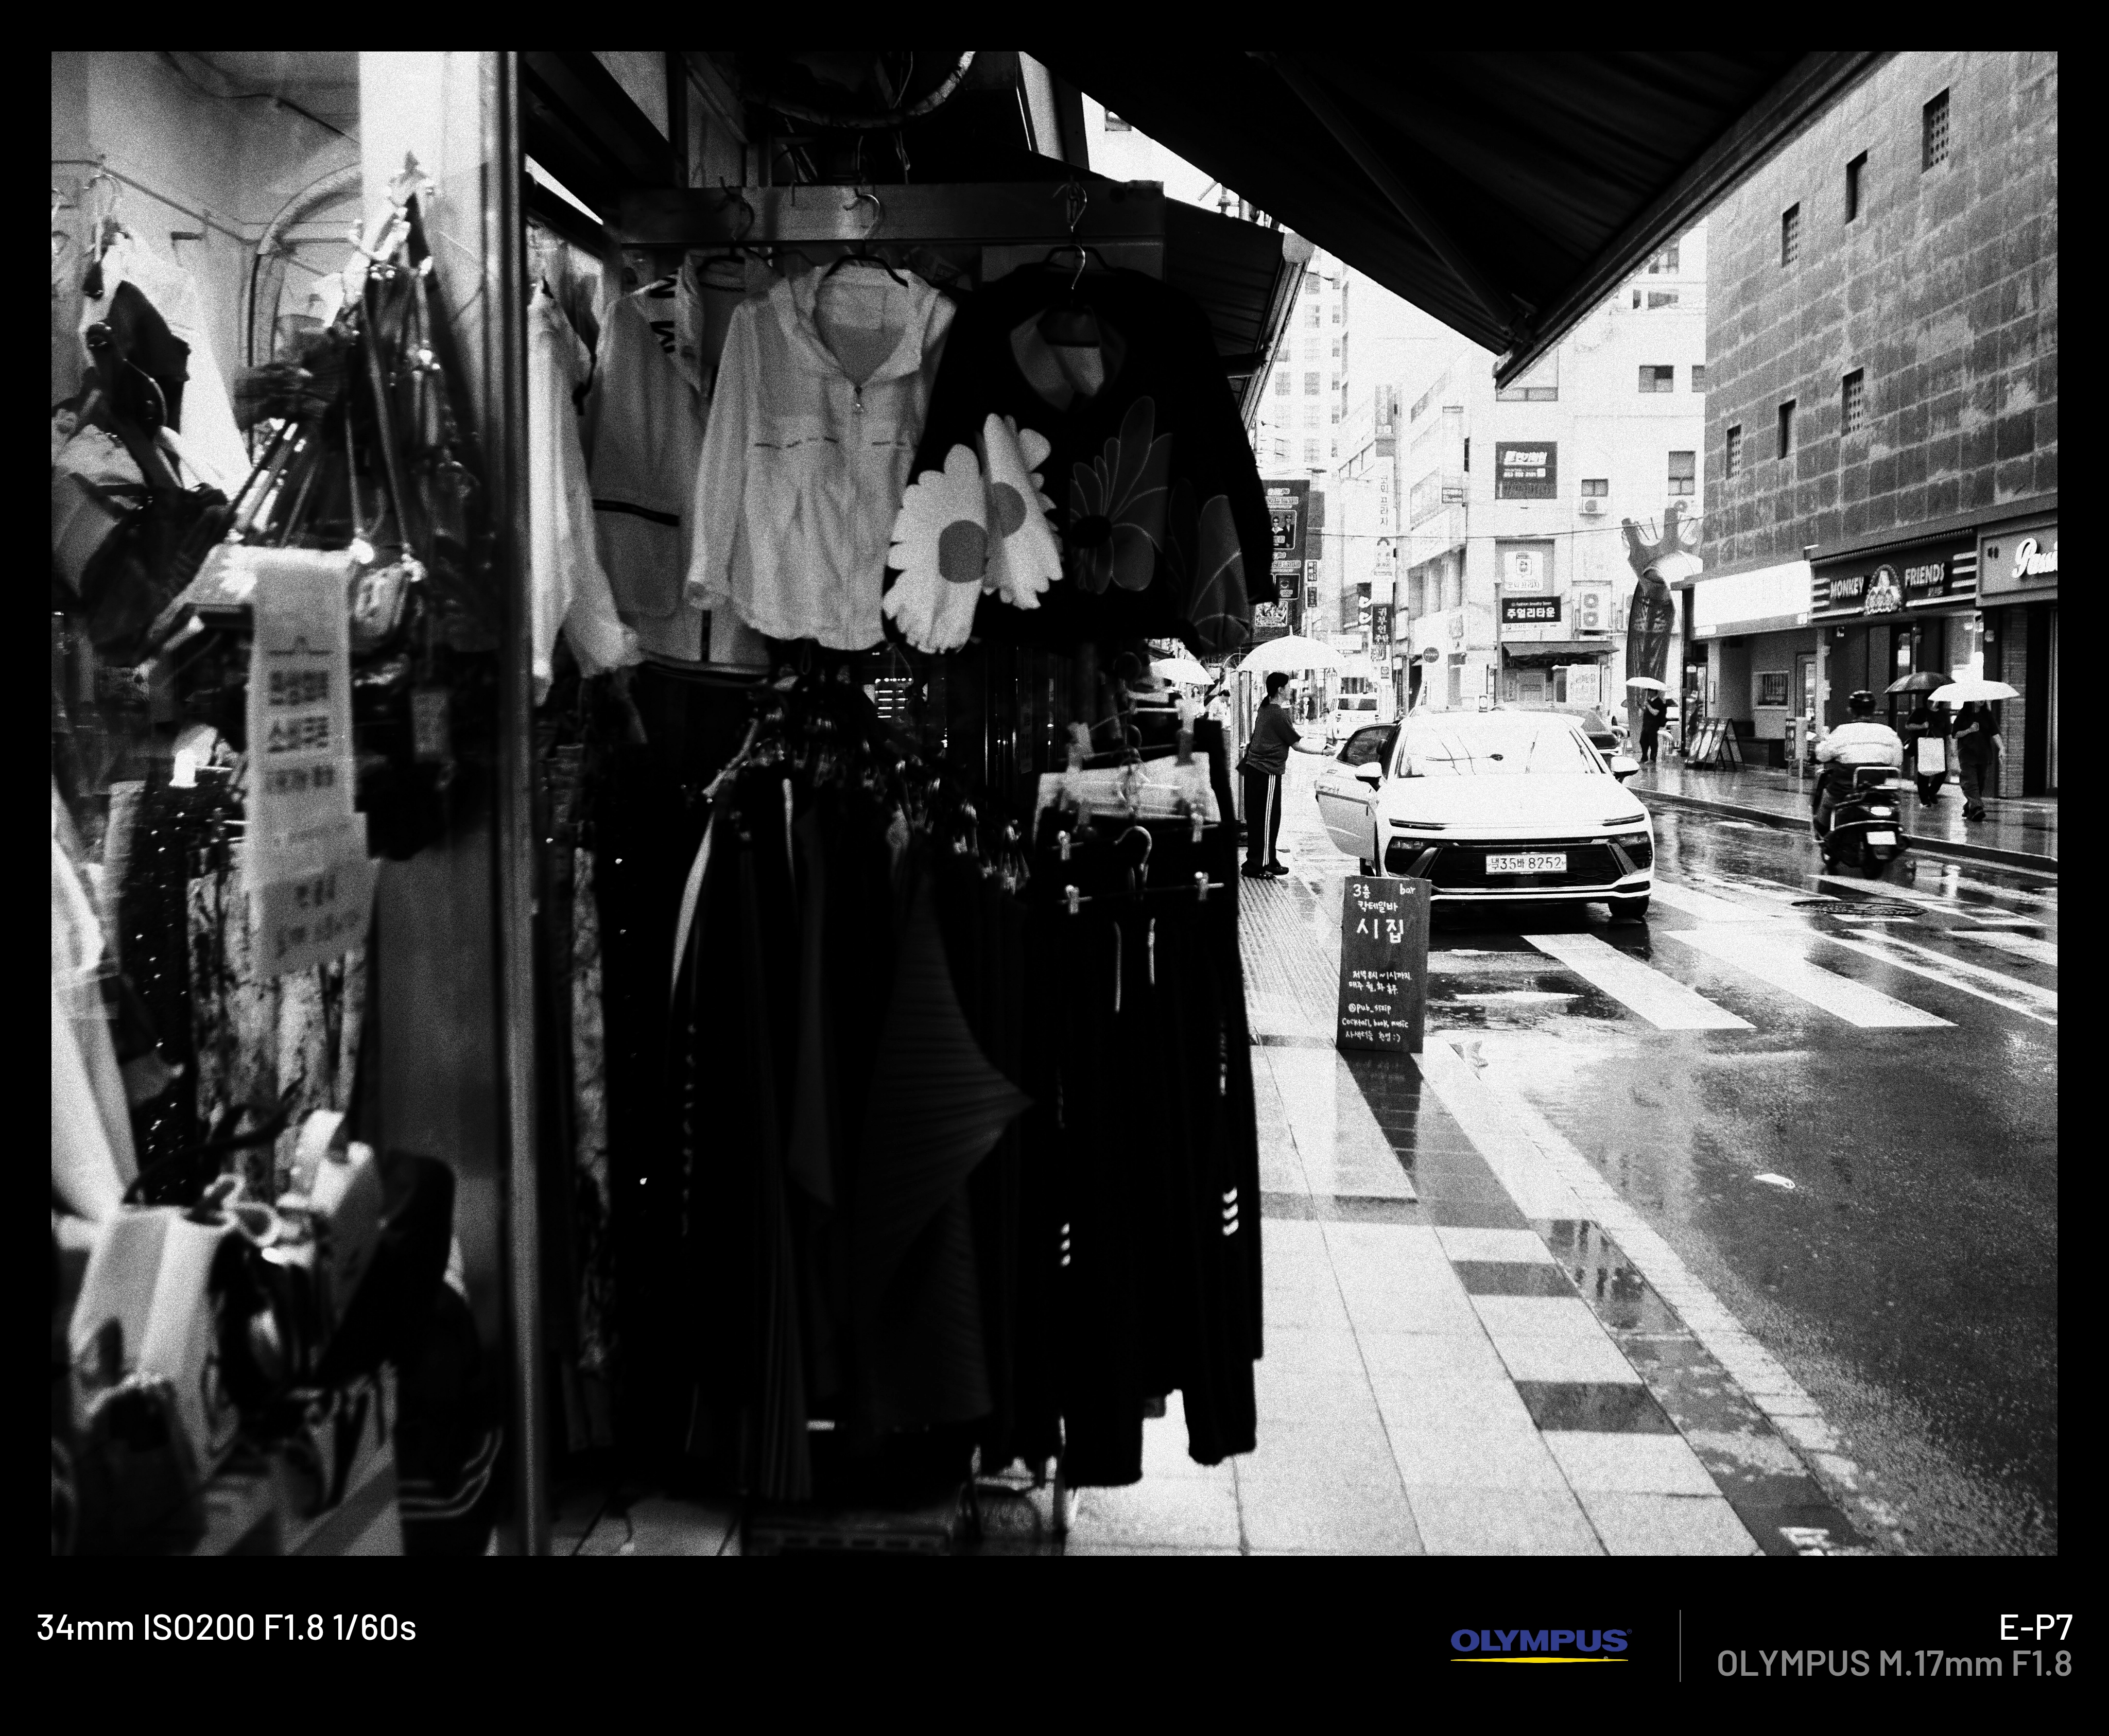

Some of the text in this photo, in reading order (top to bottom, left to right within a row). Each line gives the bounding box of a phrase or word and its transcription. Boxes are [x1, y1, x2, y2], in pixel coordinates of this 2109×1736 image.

[1830, 562, 1945, 599] MONKEY FRIENDS
[1507, 606, 1555, 619] 주얼리타운
[1528, 856, 1561, 869] 8252
[1353, 883, 1371, 899] 3층
[1358, 900, 1398, 913] 칵테일바
